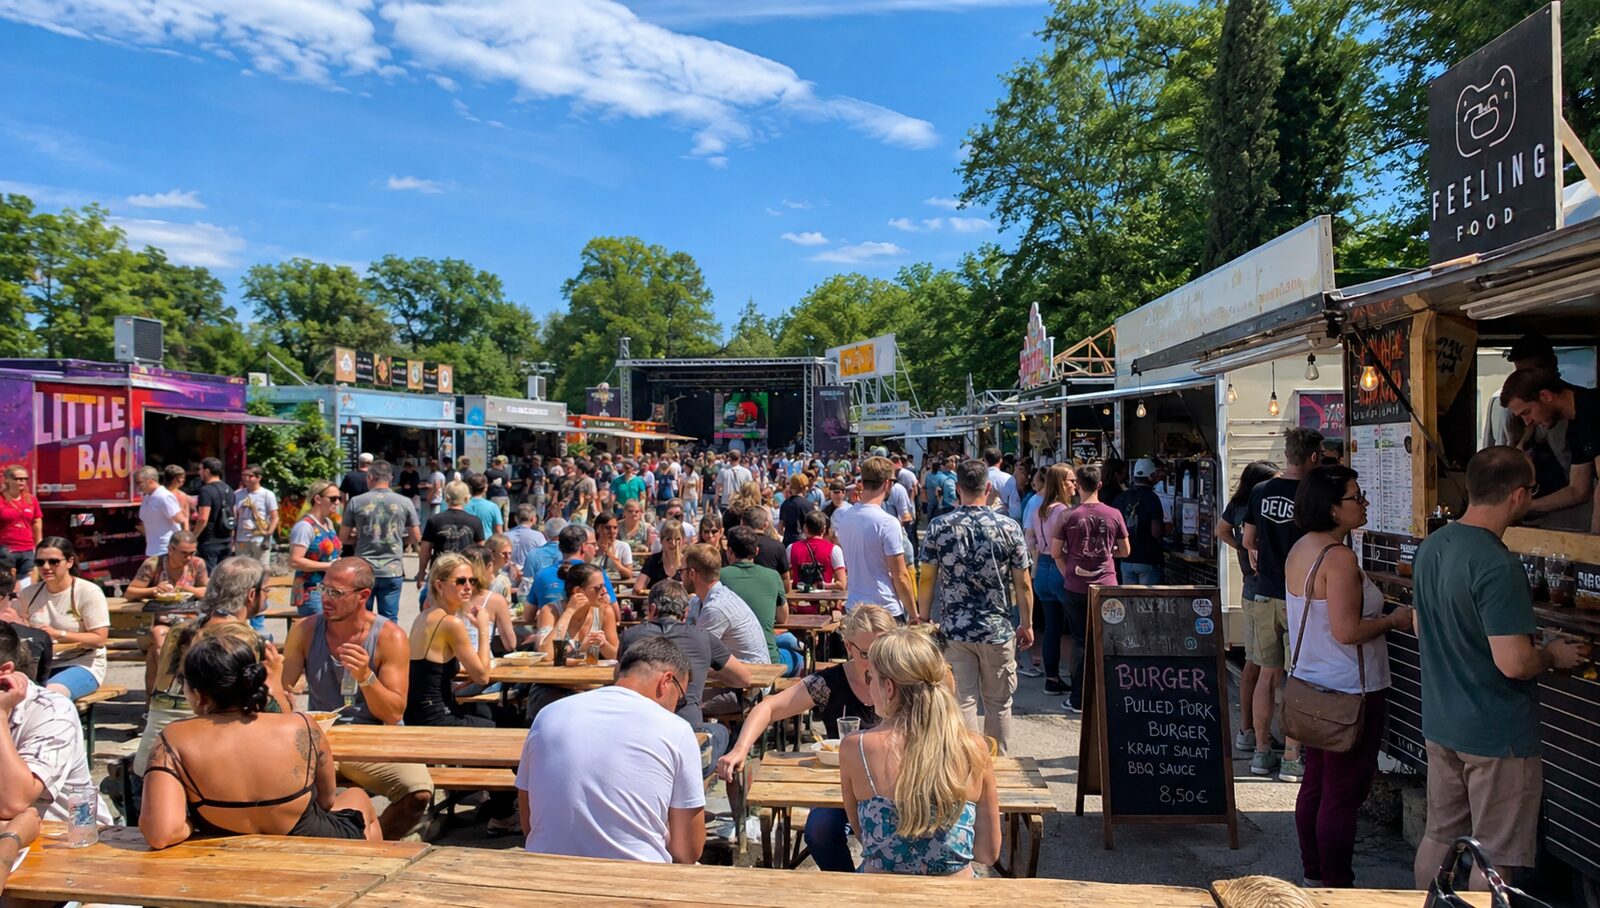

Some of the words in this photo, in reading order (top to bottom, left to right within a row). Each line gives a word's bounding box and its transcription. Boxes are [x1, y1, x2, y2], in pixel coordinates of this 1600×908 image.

[1432, 143, 1545, 222] FEELING
[1457, 207, 1513, 242] FOOD
[35, 391, 125, 445] LITTLE
[78, 436, 130, 480] BAO
[1261, 498, 1295, 519] DEUS
[1115, 663, 1210, 694] BURGER
[1124, 696, 1174, 715] PULLED
[1179, 699, 1216, 722] PORK
[1148, 721, 1210, 745] BURGER
[1127, 741, 1168, 756] KRAUT
[1173, 745, 1210, 760] SALAT
[1128, 761, 1154, 776] BBQ
[1159, 762, 1196, 776] SAUCE
[1159, 785, 1208, 806] 8,50€
